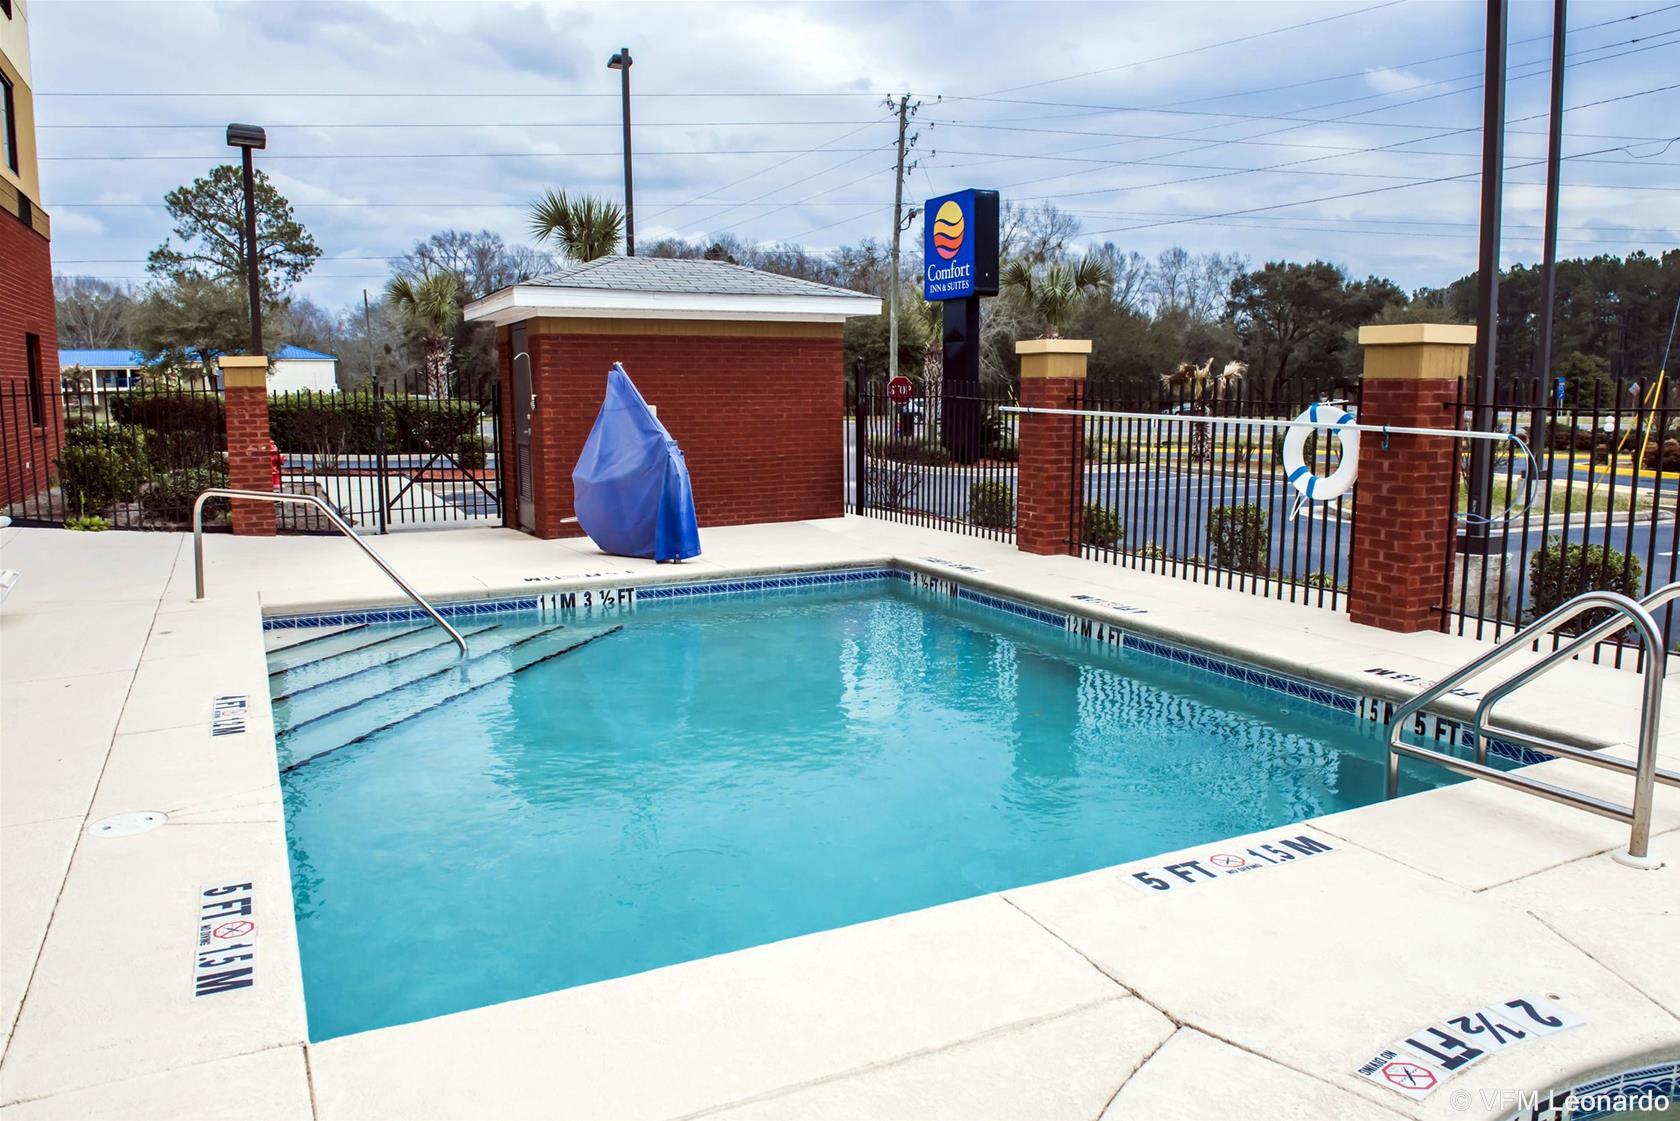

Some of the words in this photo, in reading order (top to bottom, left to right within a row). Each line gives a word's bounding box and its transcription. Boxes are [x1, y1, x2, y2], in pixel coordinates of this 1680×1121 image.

[927, 260, 970, 281] Comfort
[584, 591, 592, 606] 3
[618, 587, 634, 603] FT
[1097, 623, 1104, 641] 4
[1108, 626, 1123, 647] FT
[1414, 711, 1426, 736] 5
[1434, 717, 1460, 745] FT
[1132, 872, 1170, 891] 5
[1163, 860, 1218, 883] FT
[203, 882, 252, 897] 5
[201, 896, 252, 921] FT
[1504, 1000, 1563, 1028] 2
[1380, 1049, 1398, 1060] NO
[1404, 1027, 1484, 1071] FT
[1358, 1057, 1388, 1076] DIVING
